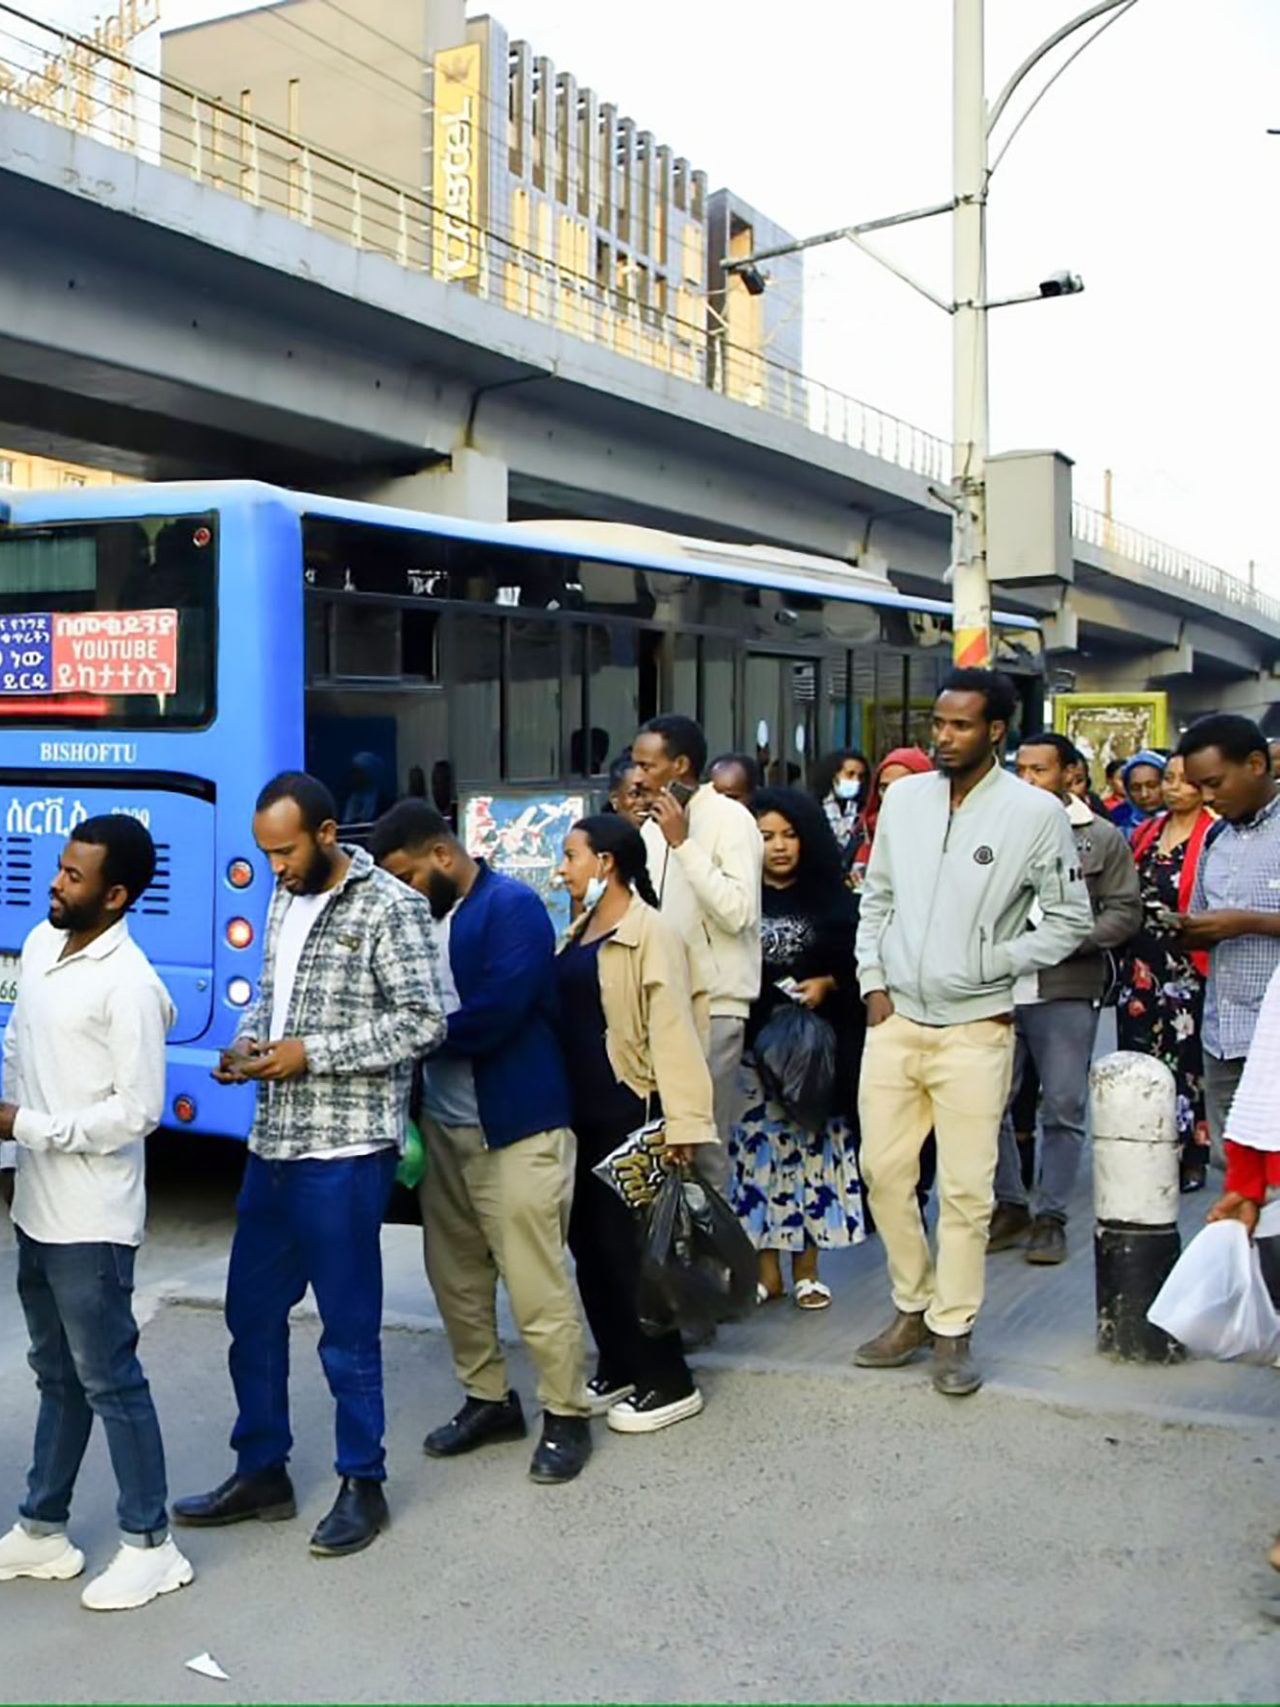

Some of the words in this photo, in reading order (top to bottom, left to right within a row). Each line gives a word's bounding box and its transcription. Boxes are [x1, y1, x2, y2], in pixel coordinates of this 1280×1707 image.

[57, 615, 174, 637] በመቄዶንያ
[10, 650, 45, 669] ነው
[71, 639, 159, 660] YOUTUBE
[57, 662, 172, 688] ይከታተሉን
[39, 742, 137, 764] BISHOFTU
